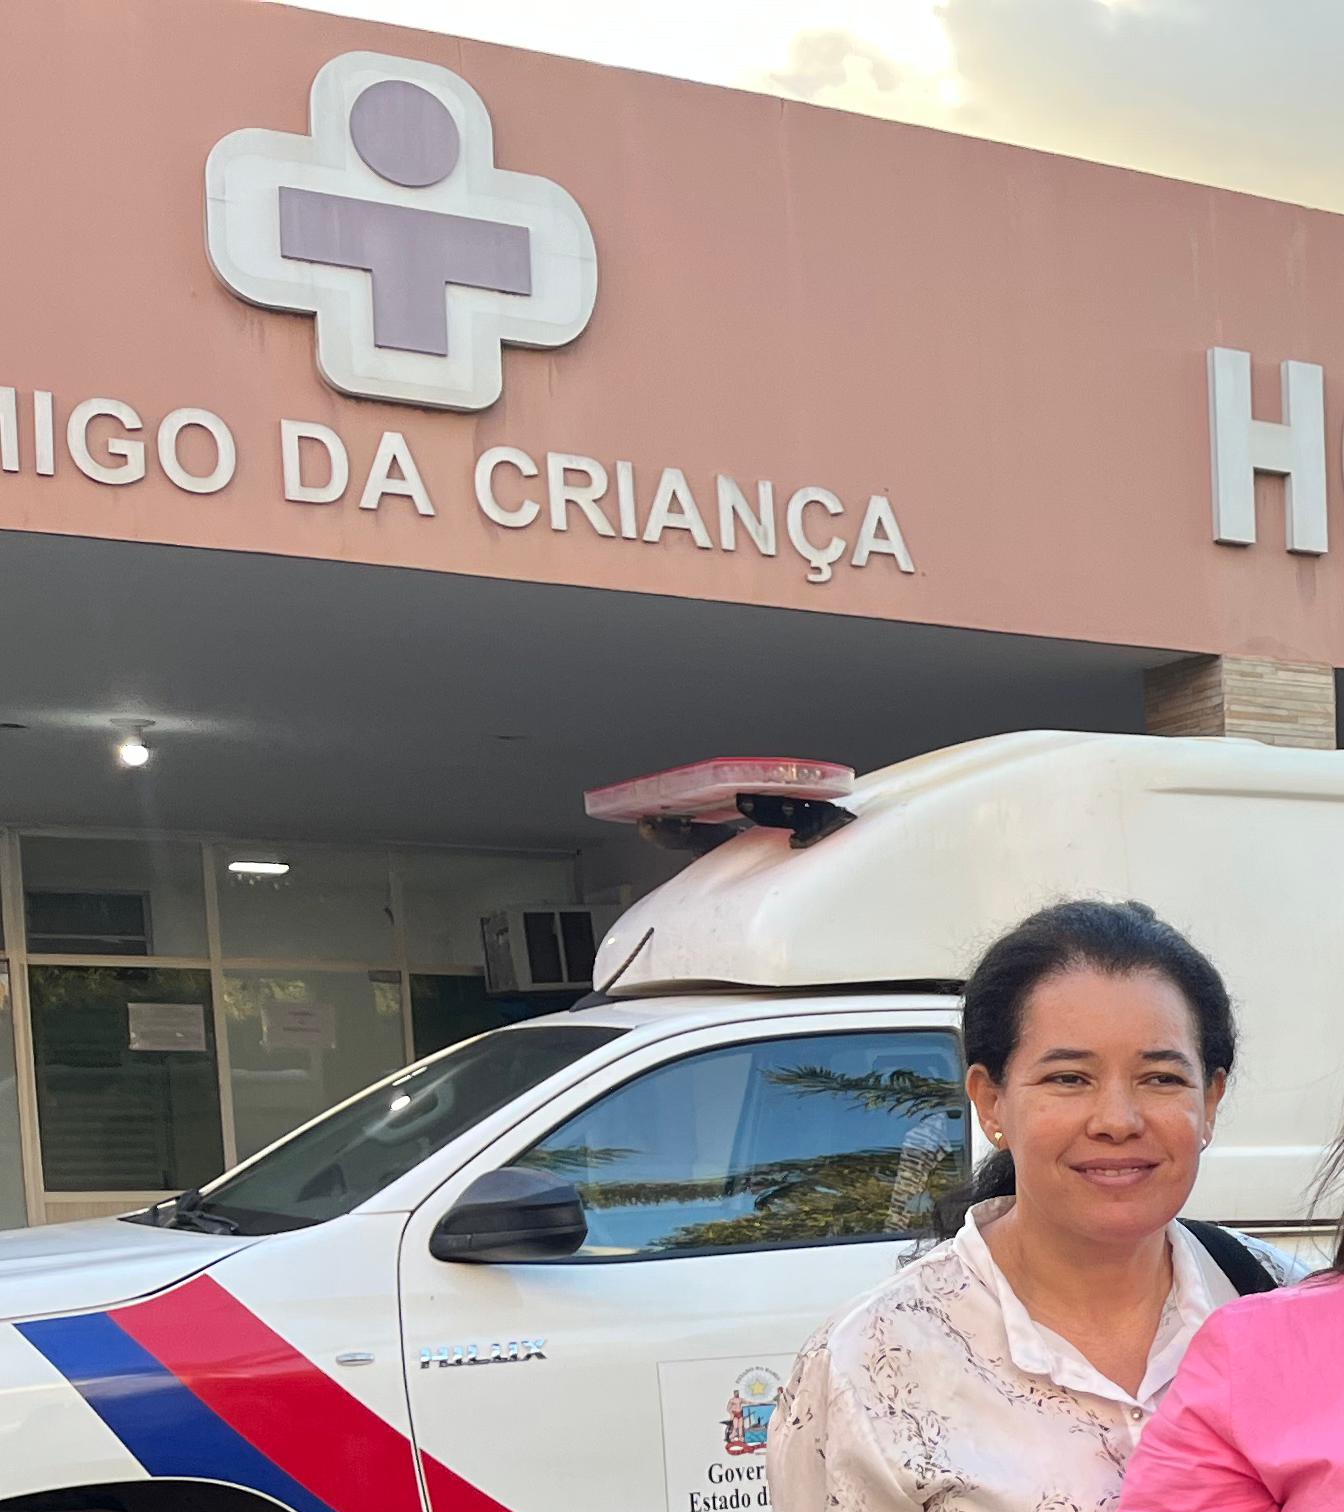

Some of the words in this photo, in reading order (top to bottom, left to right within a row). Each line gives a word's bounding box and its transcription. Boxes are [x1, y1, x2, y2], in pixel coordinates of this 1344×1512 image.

[0, 386, 237, 495] IGO
[281, 419, 436, 517] DA
[475, 447, 915, 582] CRIANÇA
[420, 1338, 548, 1369] HILUX
[689, 1489, 751, 1512] Estado
[757, 1486, 772, 1506] d
